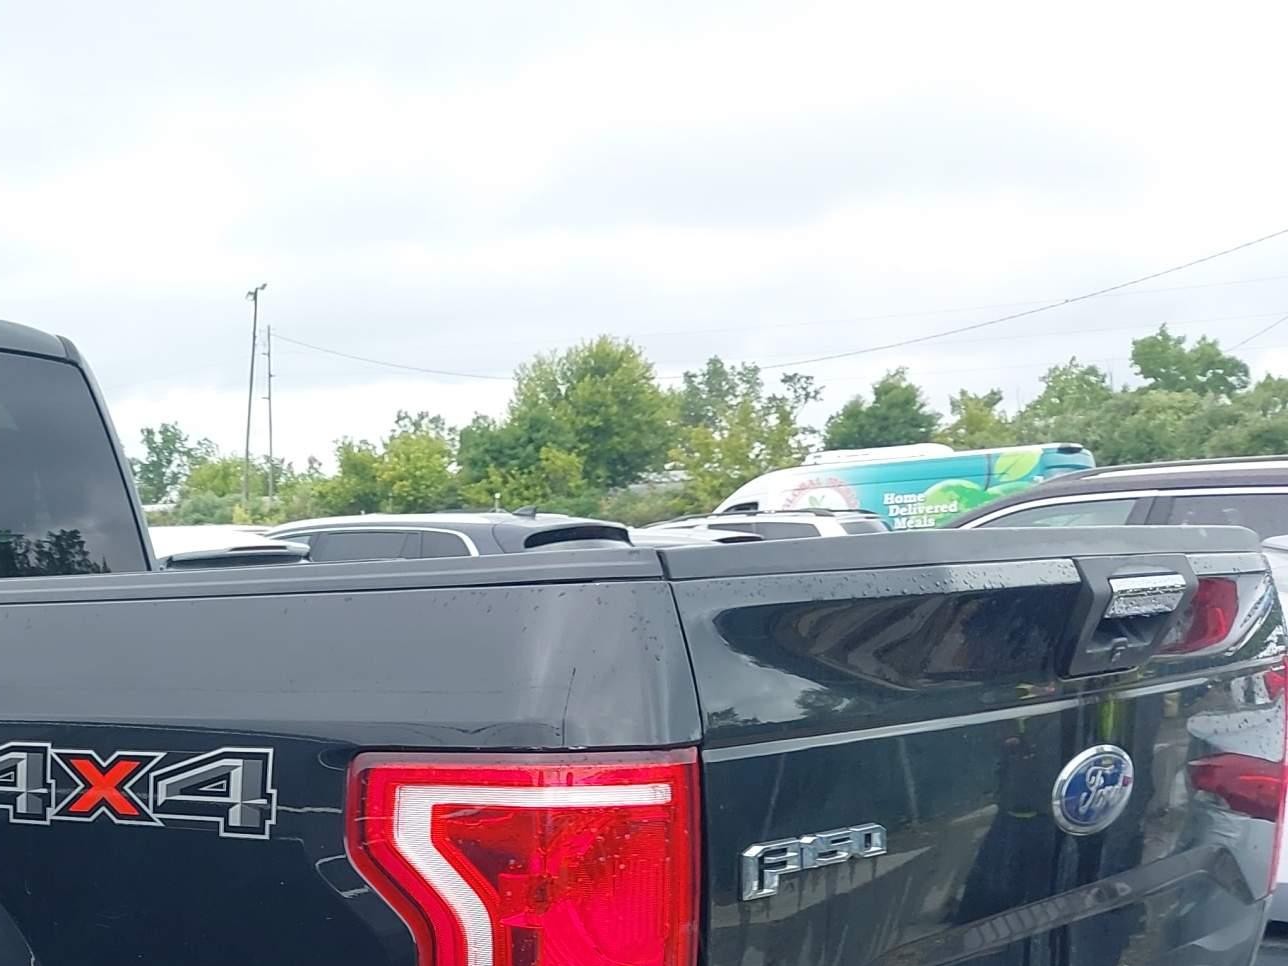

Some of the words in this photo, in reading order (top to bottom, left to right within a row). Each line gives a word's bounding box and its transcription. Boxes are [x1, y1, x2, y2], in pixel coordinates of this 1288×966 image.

[884, 492, 926, 505] Home
[888, 500, 959, 517] Delivered
[893, 516, 936, 530] Meals
